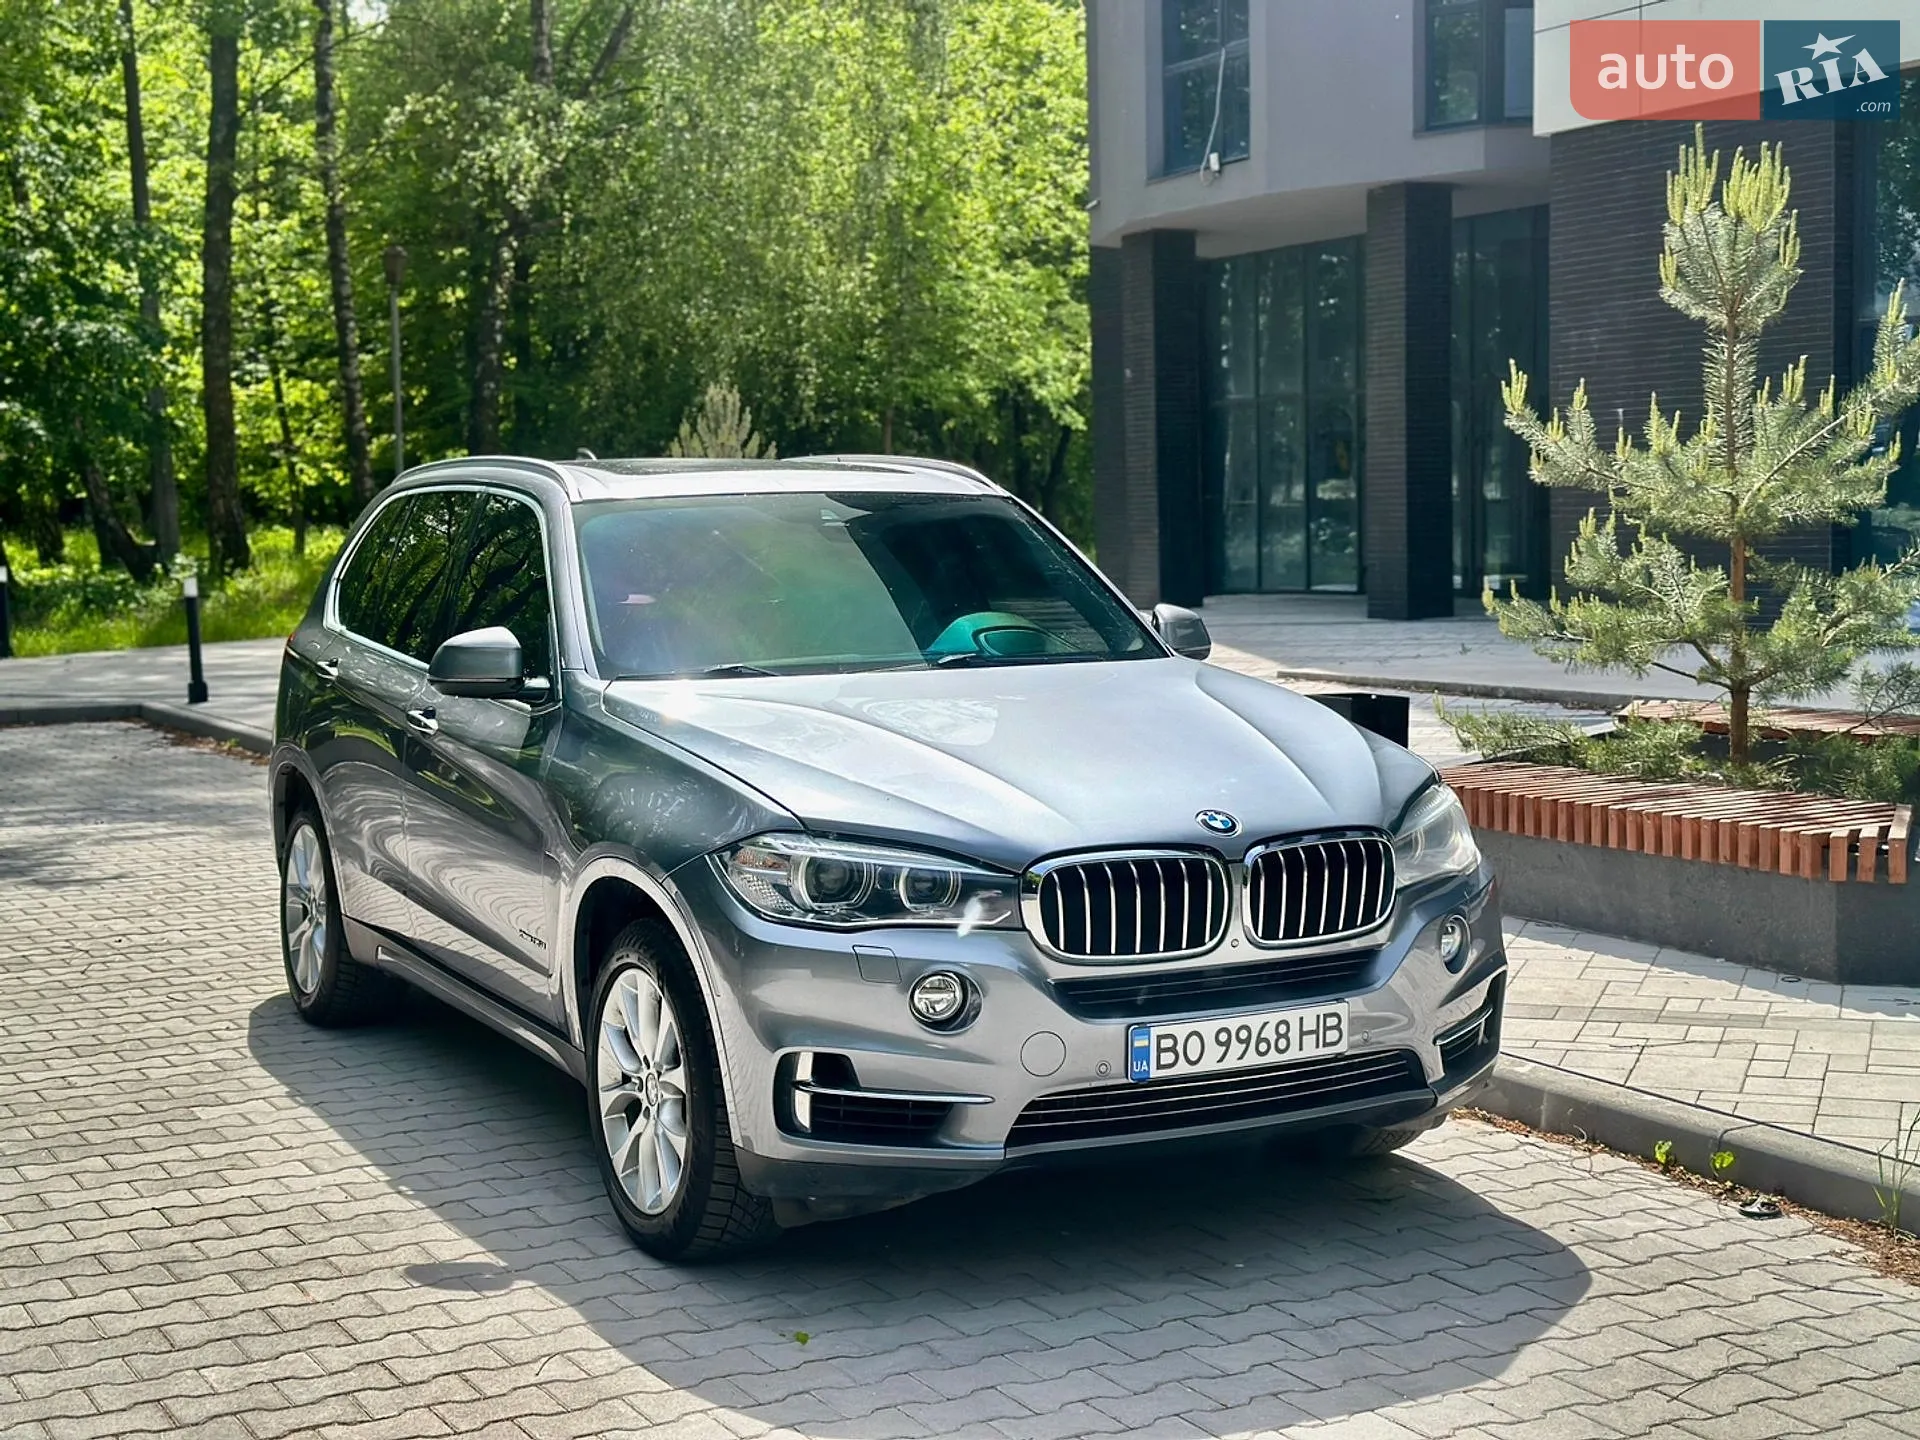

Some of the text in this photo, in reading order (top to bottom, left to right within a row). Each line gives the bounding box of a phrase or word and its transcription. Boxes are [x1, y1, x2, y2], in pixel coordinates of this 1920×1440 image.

[1155, 1011, 1344, 1071] BO 9968 HB
[1132, 1059, 1149, 1073] UA
